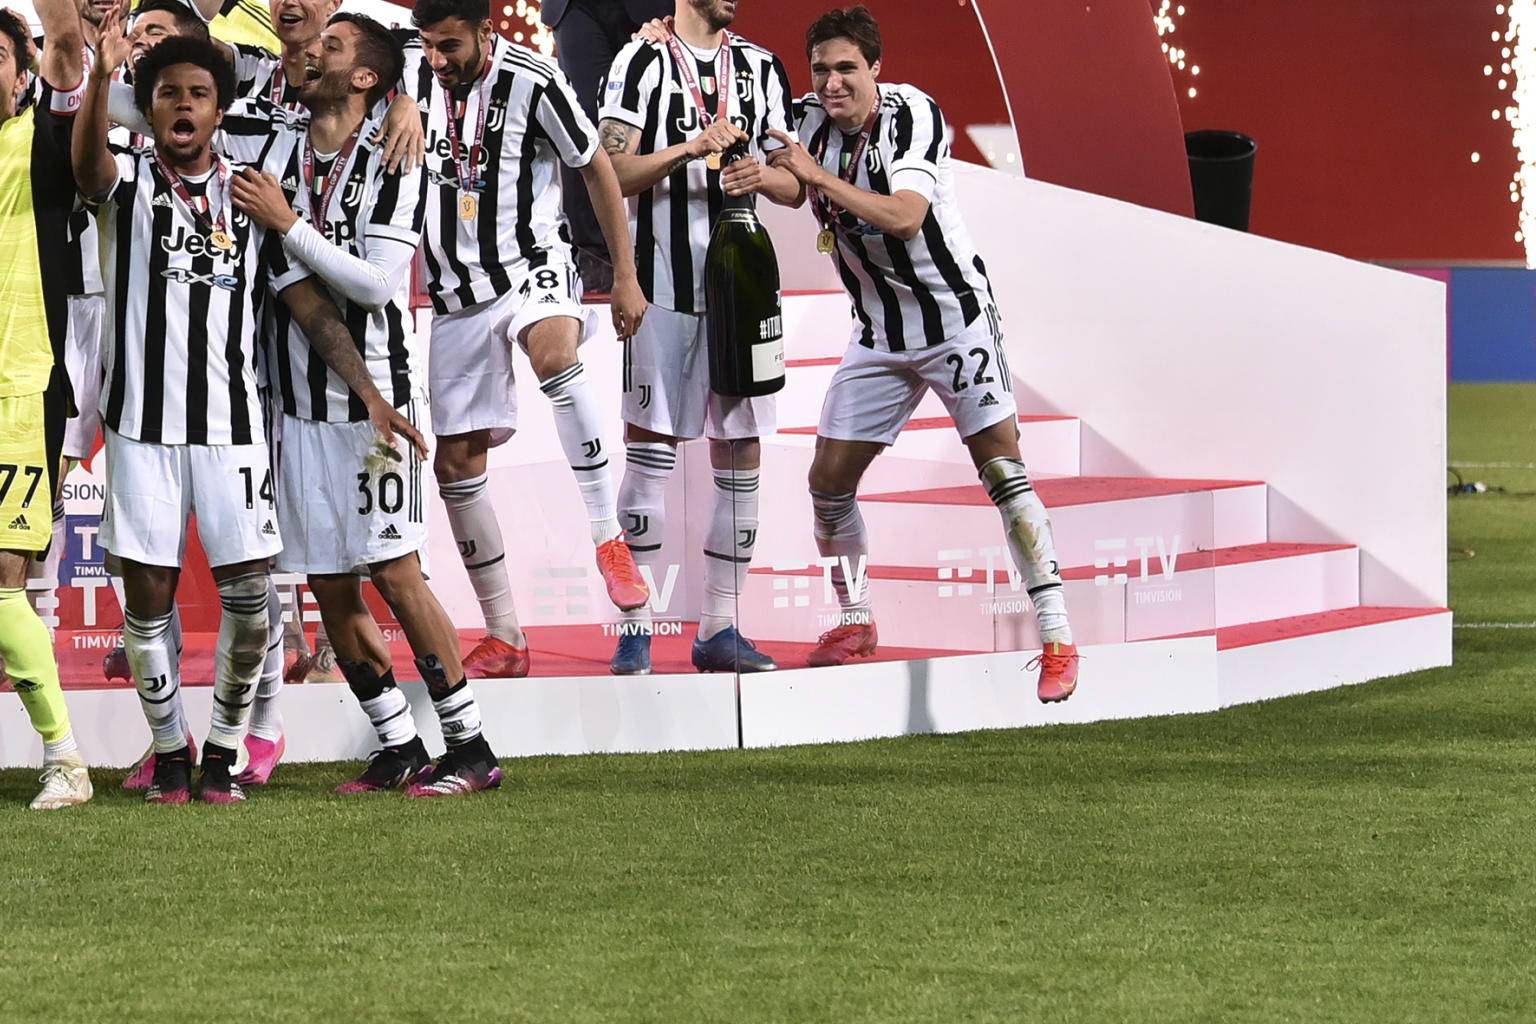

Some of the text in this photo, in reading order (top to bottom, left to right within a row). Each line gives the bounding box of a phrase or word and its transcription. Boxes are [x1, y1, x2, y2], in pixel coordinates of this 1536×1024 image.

[161, 226, 241, 265] Jeep
[946, 347, 995, 393] 22
[238, 467, 274, 510] 14
[357, 472, 404, 515] 30
[815, 555, 867, 604] TV
[1133, 535, 1181, 583] TV
[1134, 589, 1182, 604] TIMVISION
[601, 623, 682, 637] TIMVISION
[817, 612, 869, 626] TIMVISION
